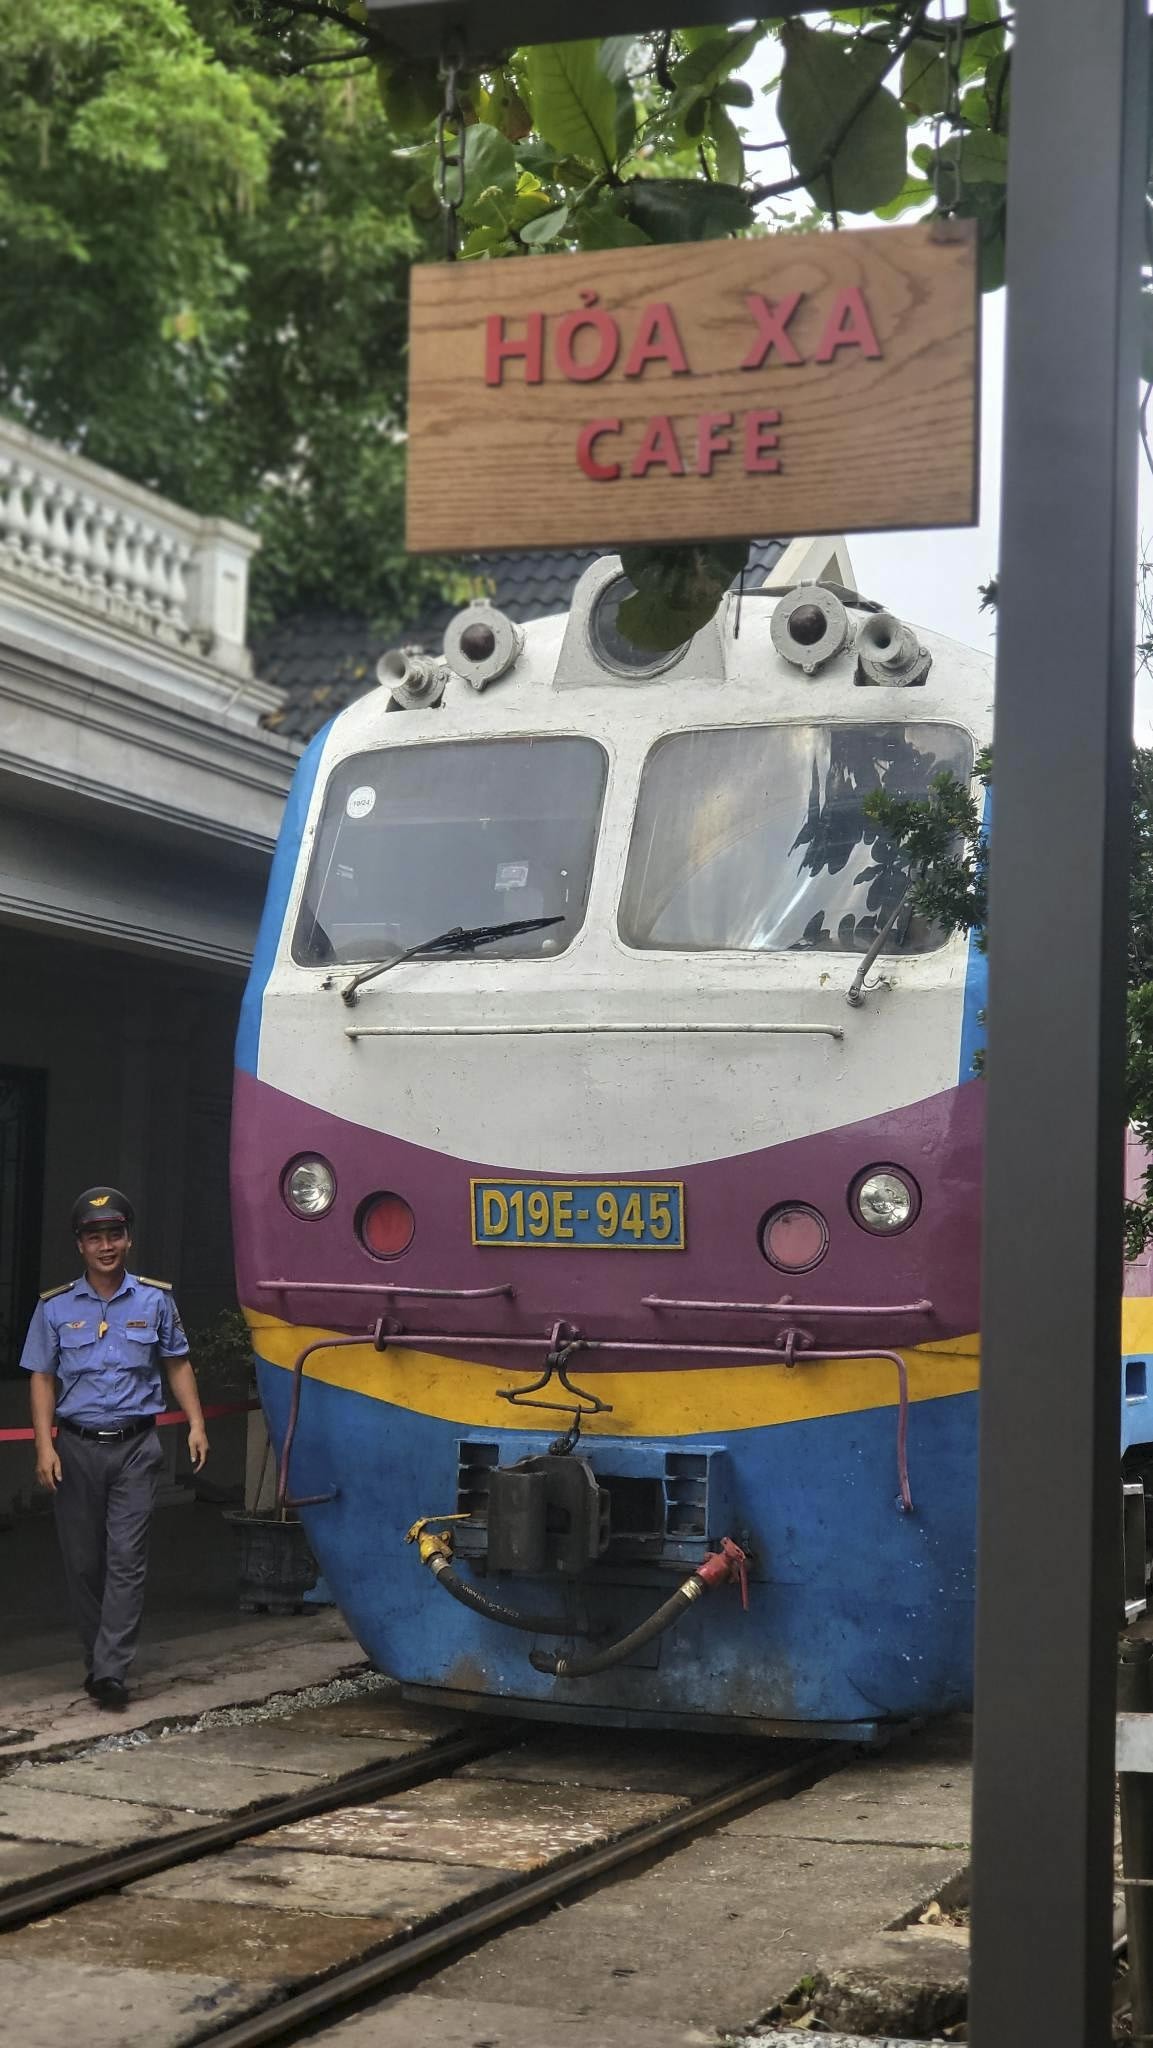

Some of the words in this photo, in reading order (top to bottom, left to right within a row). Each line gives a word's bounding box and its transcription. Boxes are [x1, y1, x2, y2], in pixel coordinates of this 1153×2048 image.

[485, 287, 691, 386] HỎA
[741, 286, 882, 371] XA
[576, 410, 783, 481] CAFE
[482, 1189, 673, 1240] D19E-945
